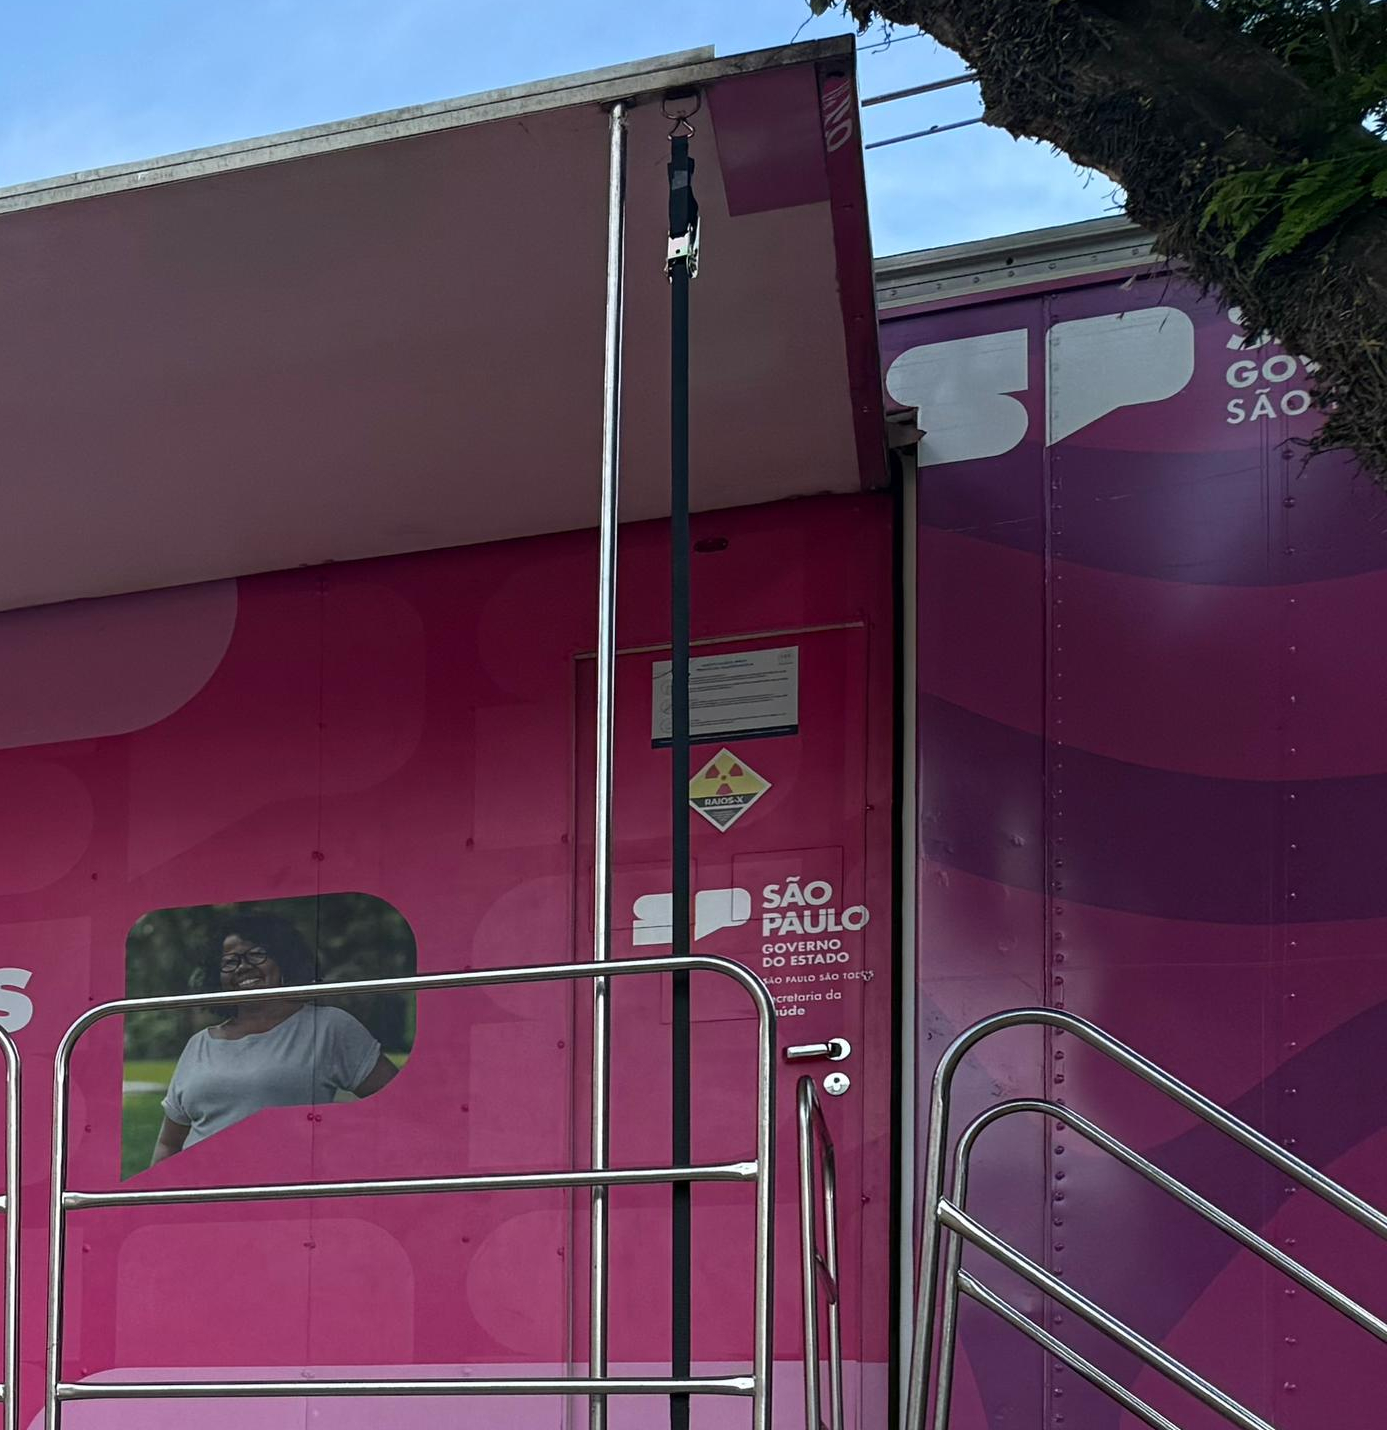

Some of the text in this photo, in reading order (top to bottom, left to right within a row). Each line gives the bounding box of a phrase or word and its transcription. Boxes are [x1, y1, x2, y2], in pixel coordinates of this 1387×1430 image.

[1227, 387, 1311, 424] SÃO
[762, 876, 832, 909] SÃO
[762, 905, 870, 937] PAULO
[762, 939, 841, 954] GOVERNO
[763, 952, 849, 968] DO ESTADO
[786, 974, 815, 984] PAULO
[825, 989, 841, 1000] da
